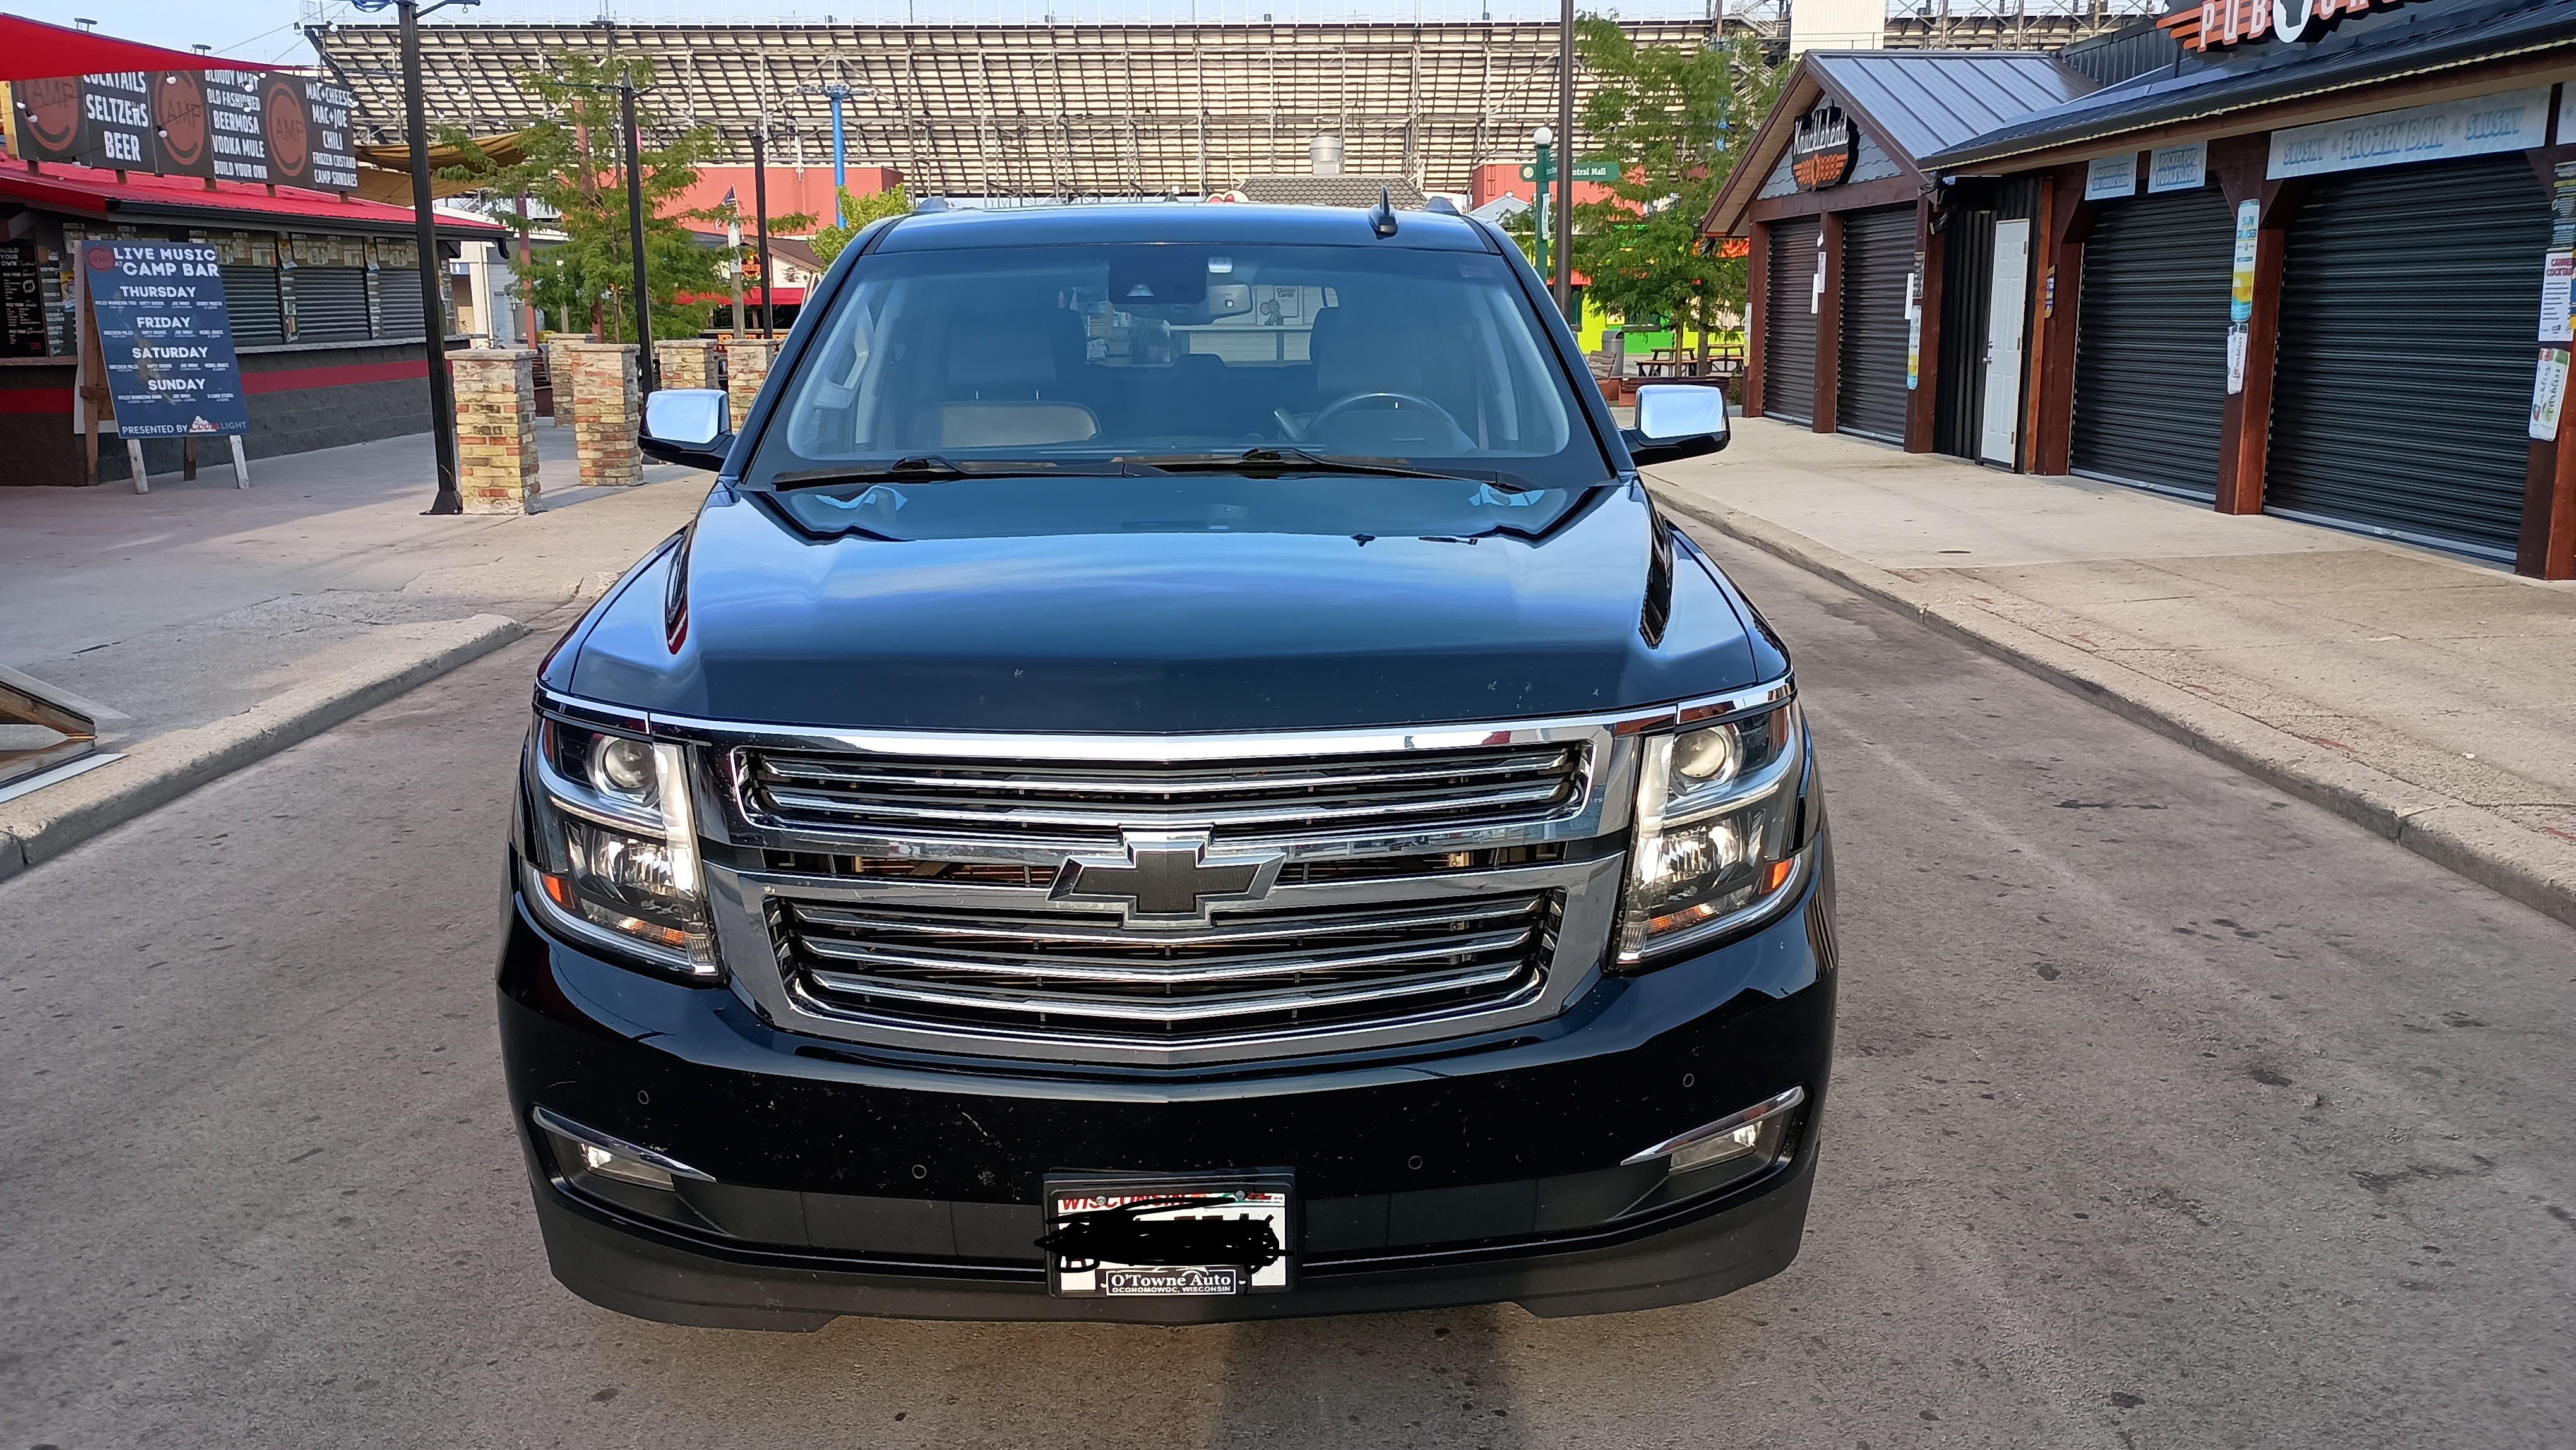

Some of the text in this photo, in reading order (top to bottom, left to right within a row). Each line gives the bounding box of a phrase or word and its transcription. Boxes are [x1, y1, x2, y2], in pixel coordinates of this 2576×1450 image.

[2200, 0, 2267, 49] PUB
[205, 69, 234, 86] BLOODY
[206, 88, 261, 111] OLD FASHIONED
[86, 93, 149, 128] SELTZERS
[167, 99, 202, 127] AMP
[312, 104, 348, 129] MAC+JOE
[213, 110, 260, 135] BEERMOSA
[276, 116, 306, 142] AMP
[1794, 106, 1849, 155] Knucklehead
[322, 130, 343, 151] CHILI
[2283, 106, 2525, 165] SLUSHY FROZEN BAR SLUSHY
[104, 131, 141, 162] BEER
[212, 135, 265, 159] VODKA MULE
[213, 160, 268, 179] BUILD YOUR OWN
[313, 152, 356, 169] FROZEN CUSTARD
[314, 169, 358, 188] CAMP SUNDAES
[1572, 167, 1606, 176] ntral Mall
[113, 247, 155, 260] LIVE
[160, 248, 216, 261] MUSIC
[123, 262, 177, 277] CAMP
[182, 263, 220, 277] BAR
[120, 286, 196, 297] THURSDAY
[136, 316, 191, 328] FRIDAY
[132, 347, 208, 359] SATURDAY
[148, 379, 206, 391] SUNDAY
[122, 424, 174, 434] PRESENTED
[176, 424, 188, 433] BY
[220, 421, 247, 430] LIGHT
[1111, 1274, 1231, 1286] O'Towne Auto
